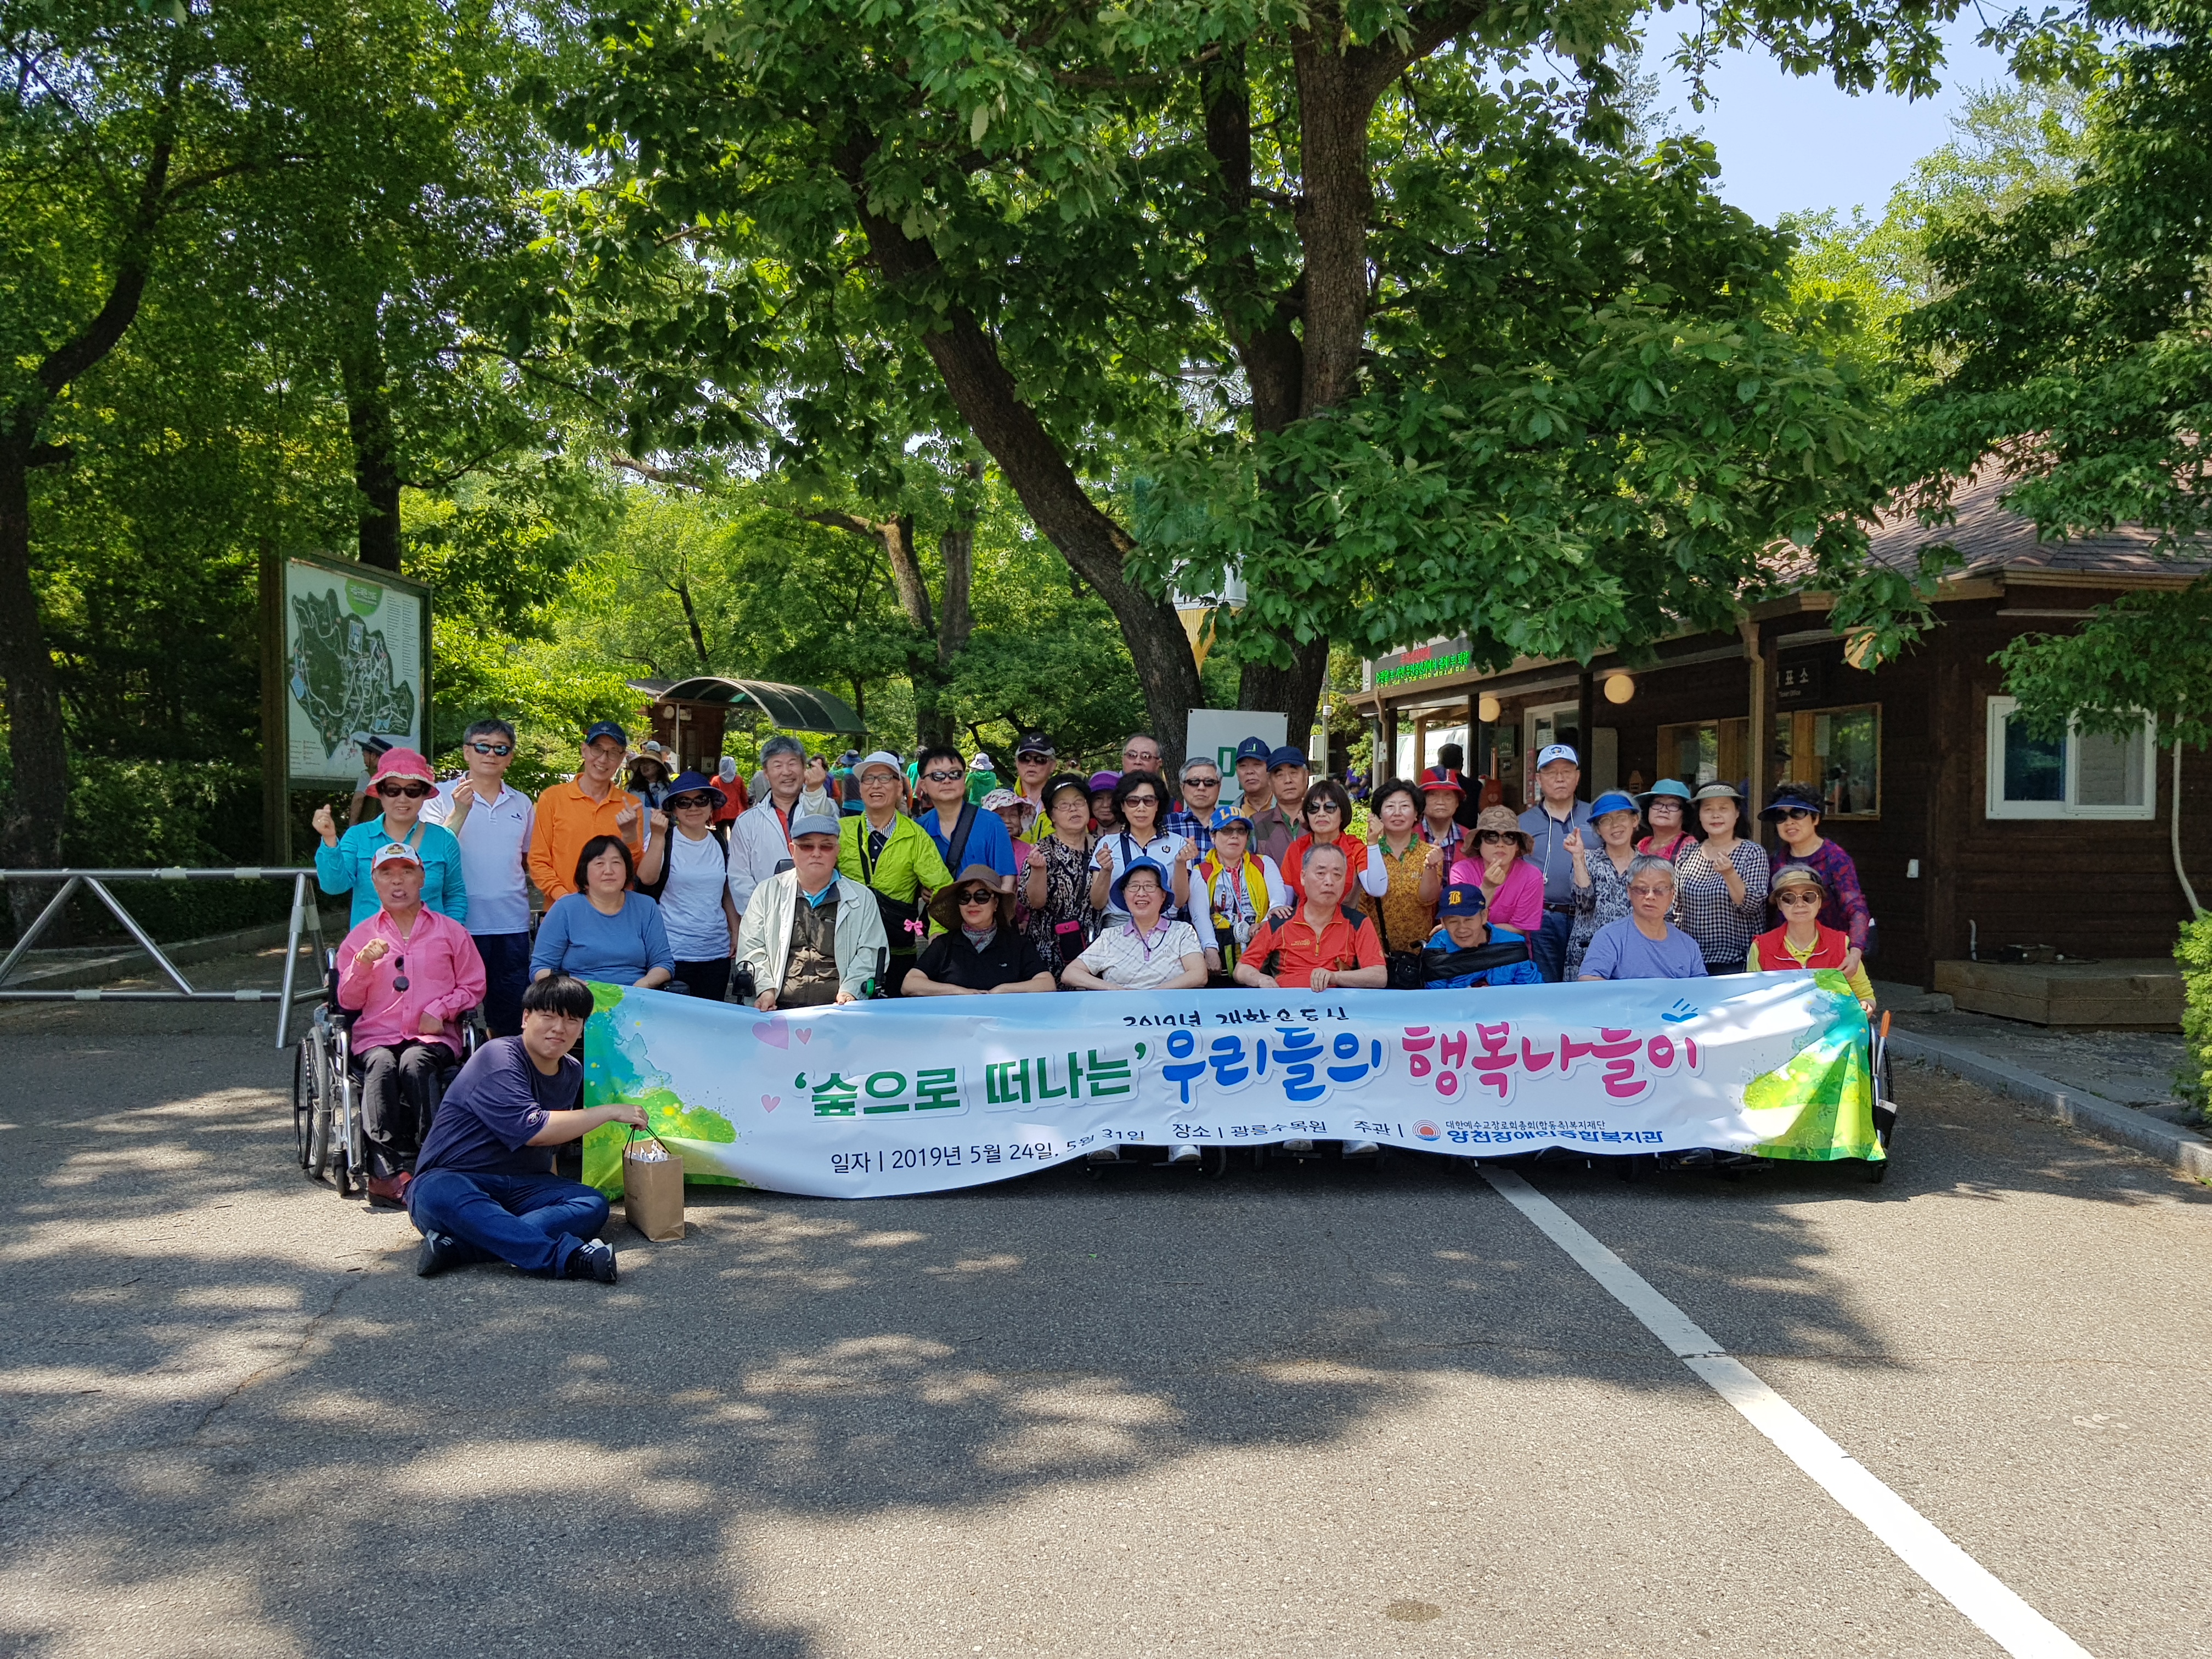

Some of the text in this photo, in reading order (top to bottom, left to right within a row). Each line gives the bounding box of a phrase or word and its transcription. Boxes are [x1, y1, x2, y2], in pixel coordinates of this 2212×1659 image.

[1776, 667, 1809, 688] 표소
[1448, 890, 1462, 905] B
[1163, 1027, 1381, 1104] 우리들의
[1402, 1021, 1697, 1098] 행복나들이
[831, 1152, 871, 1174] 일자
[892, 1145, 962, 1170] 2019년
[970, 1143, 1001, 1164] 5월
[1172, 1124, 1211, 1138] 장소
[1231, 1120, 1328, 1137] 광릉수목원
[1354, 1121, 1391, 1137] 주관
[1447, 1130, 1664, 1143] 양천장애인종합복지관
